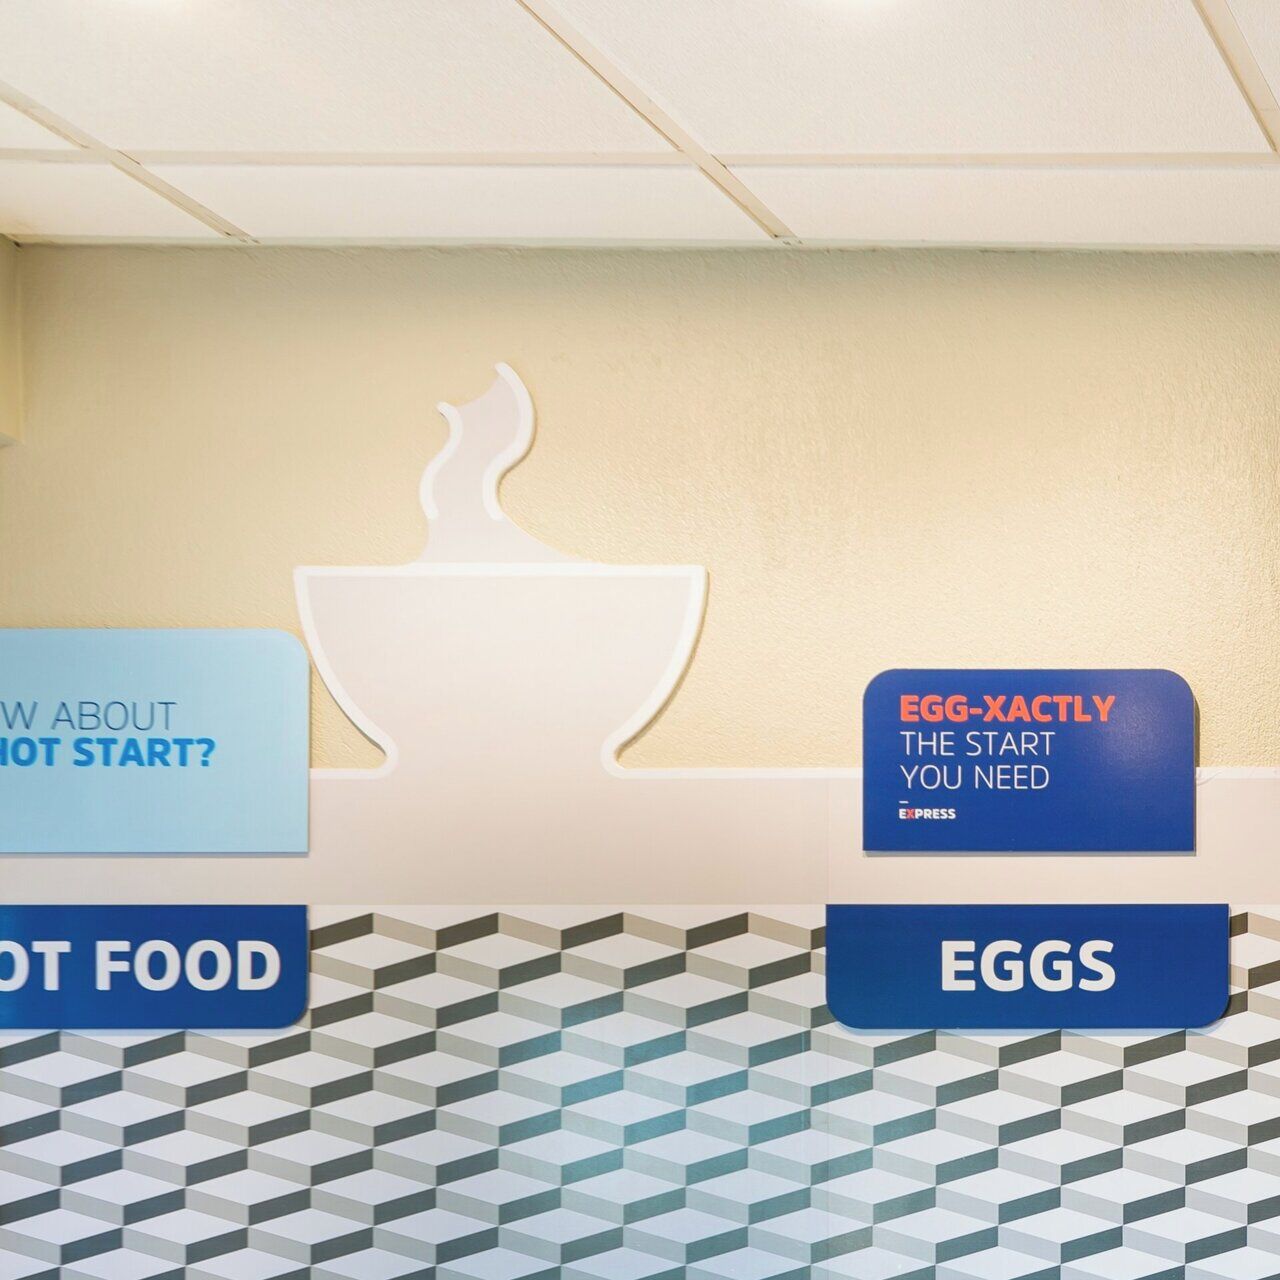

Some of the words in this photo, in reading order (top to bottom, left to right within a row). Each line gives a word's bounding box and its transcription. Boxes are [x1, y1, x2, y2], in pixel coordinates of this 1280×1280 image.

[51, 700, 177, 731] ABOUT
[899, 693, 1117, 724] EGG-XACTLY
[72, 736, 216, 768] START?
[899, 730, 955, 757] THE
[965, 730, 1056, 757] START
[899, 764, 962, 790] YOU
[974, 764, 1050, 790] NEED
[898, 807, 957, 820] EXPRESS
[0, 939, 72, 992] OT
[95, 939, 282, 992] FOOD
[941, 939, 1116, 993] EGGS
